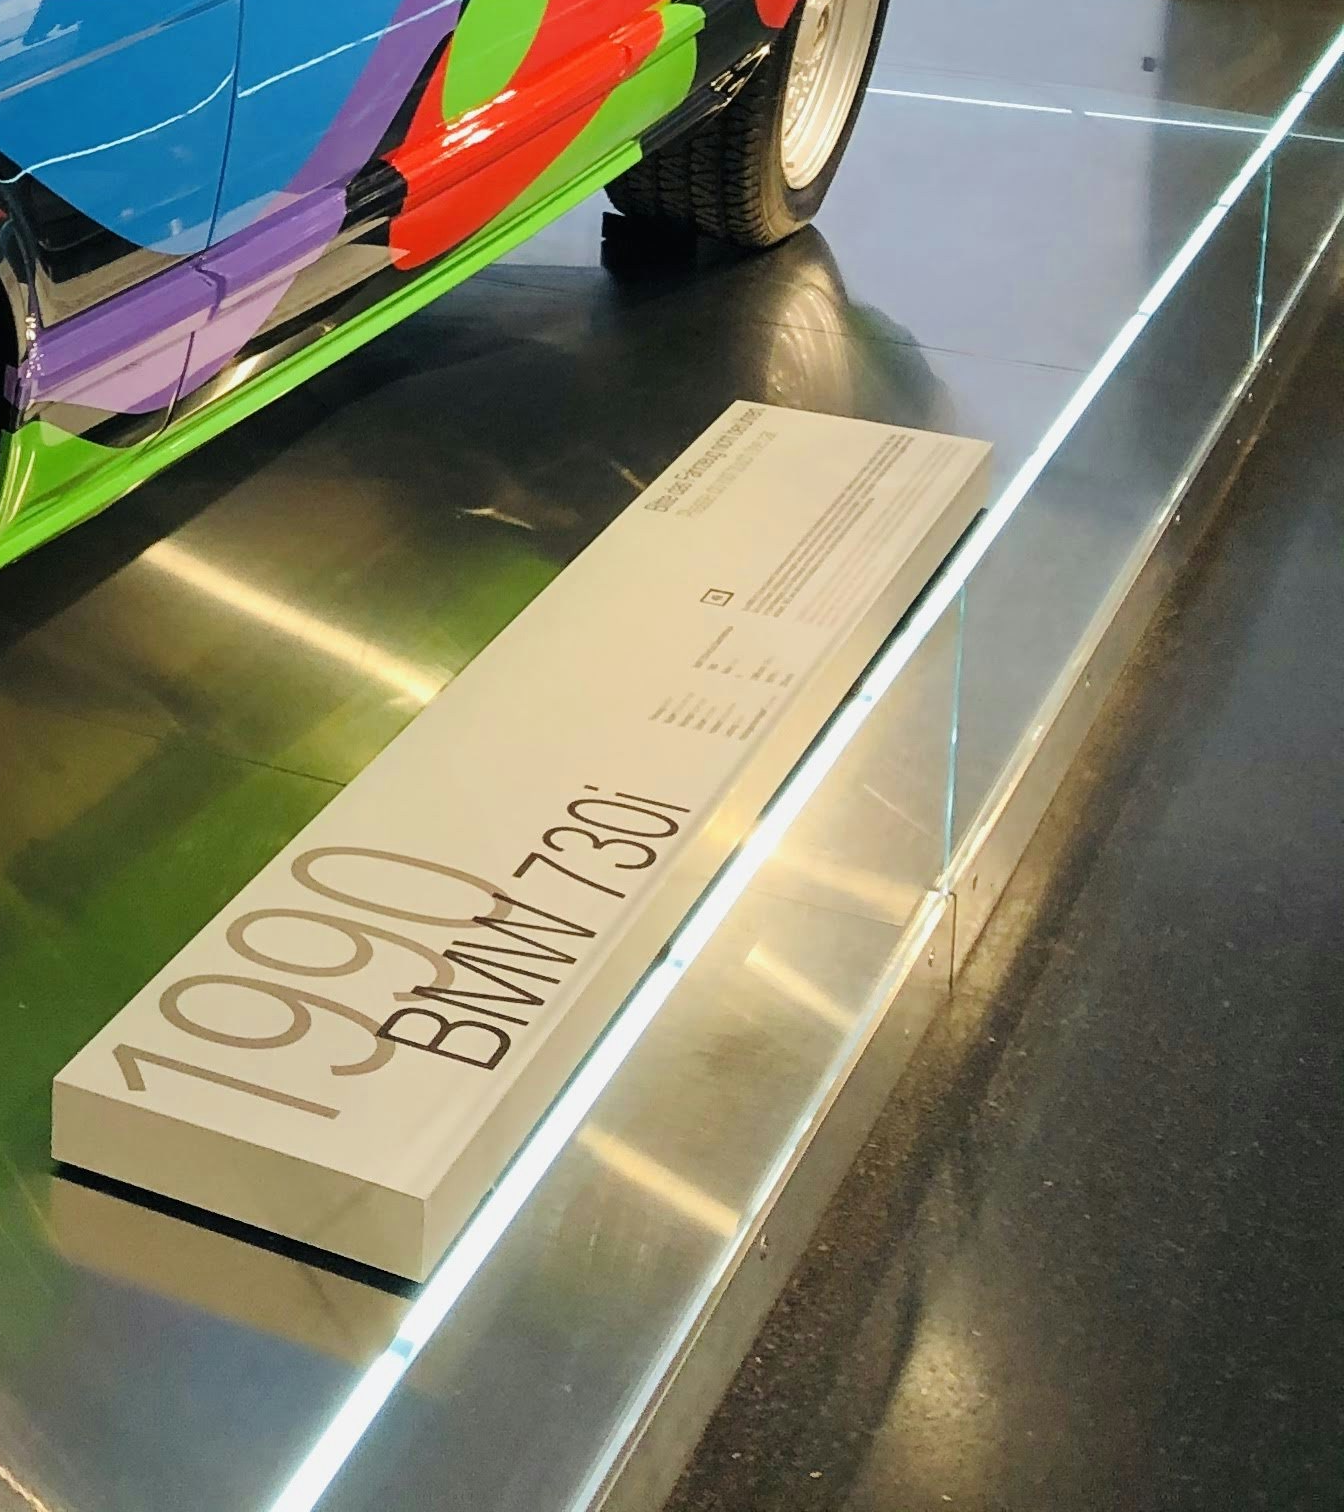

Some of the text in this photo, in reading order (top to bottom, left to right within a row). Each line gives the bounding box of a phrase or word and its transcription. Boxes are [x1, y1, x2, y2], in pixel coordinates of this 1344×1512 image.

[116, 845, 514, 1121] 1990
[377, 783, 692, 1071] BMW 730i
